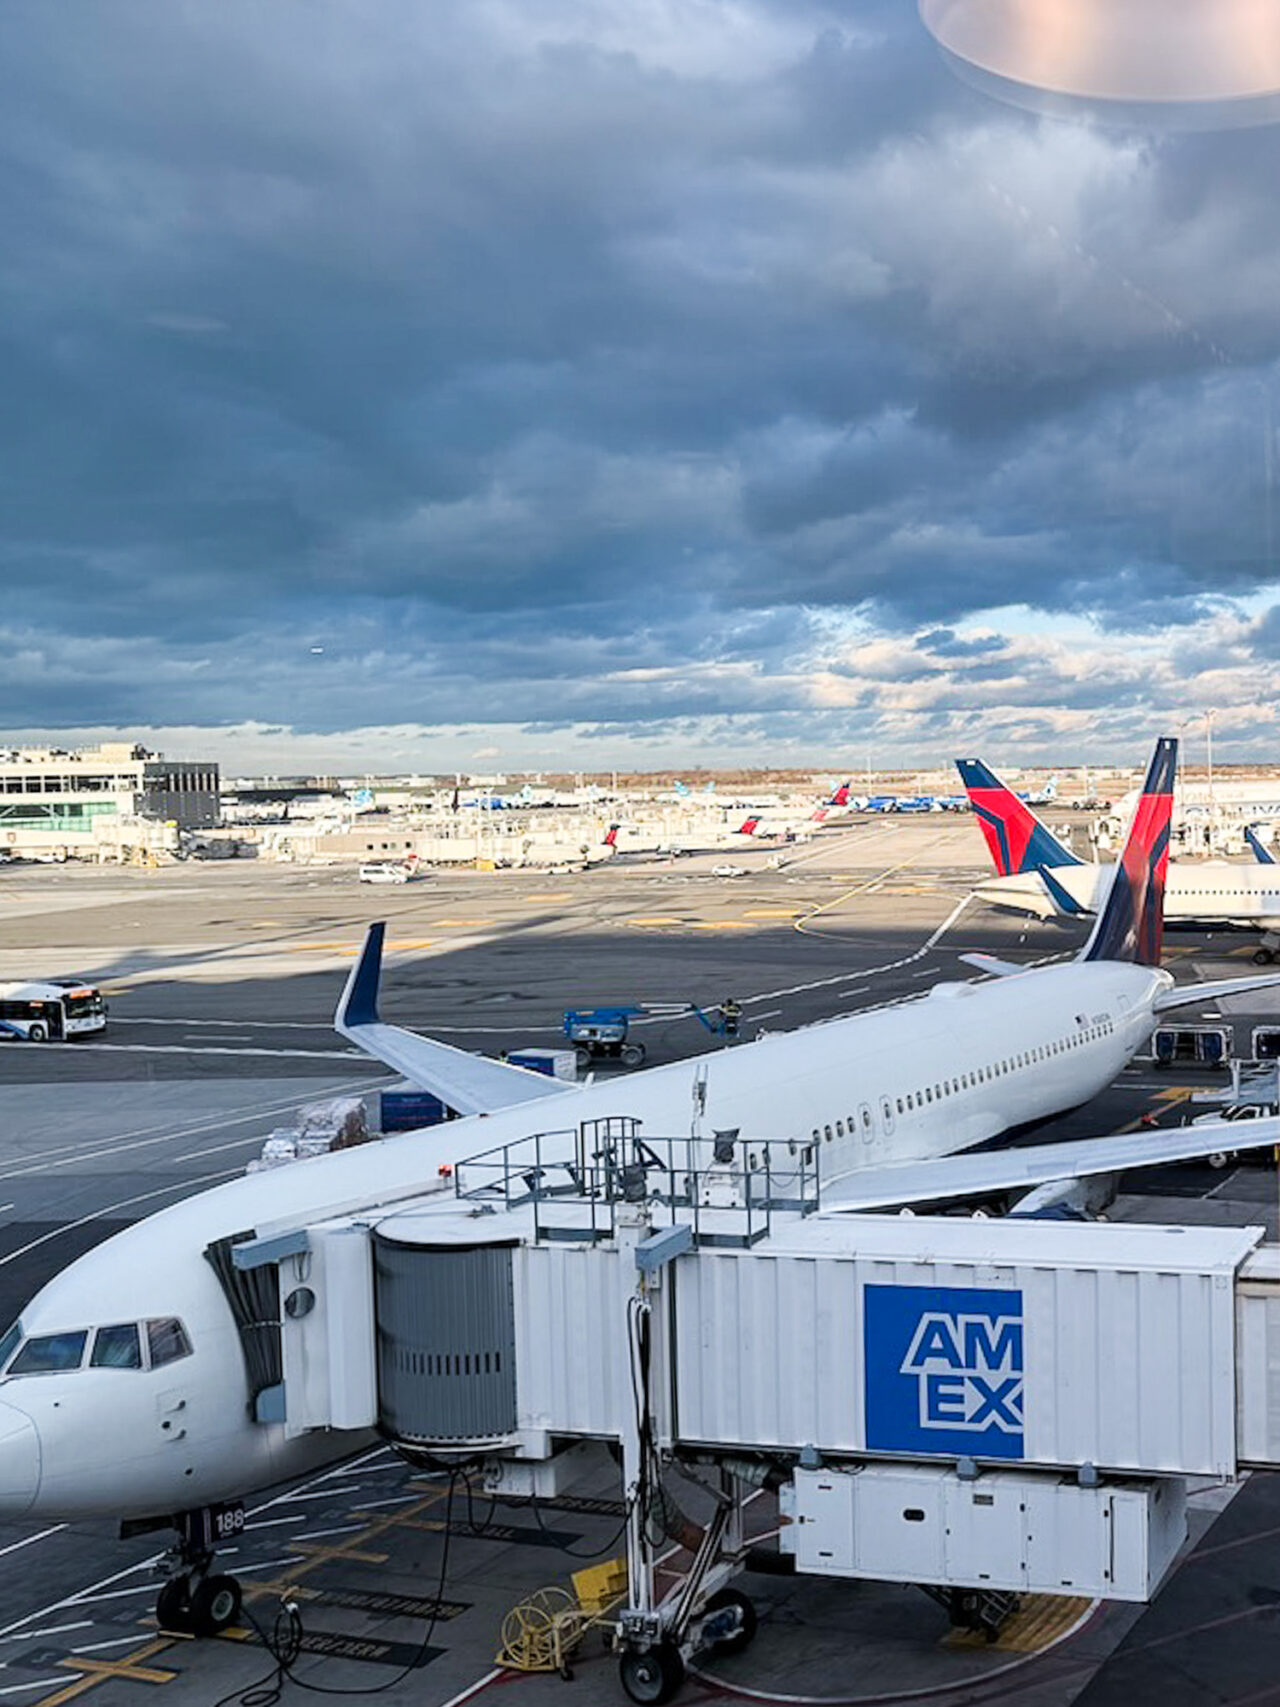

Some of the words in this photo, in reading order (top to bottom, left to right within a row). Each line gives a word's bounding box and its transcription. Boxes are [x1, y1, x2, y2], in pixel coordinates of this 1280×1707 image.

[901, 1312, 1024, 1376] AM
[920, 1373, 1024, 1433] EX
[216, 1509, 244, 1532] 188
